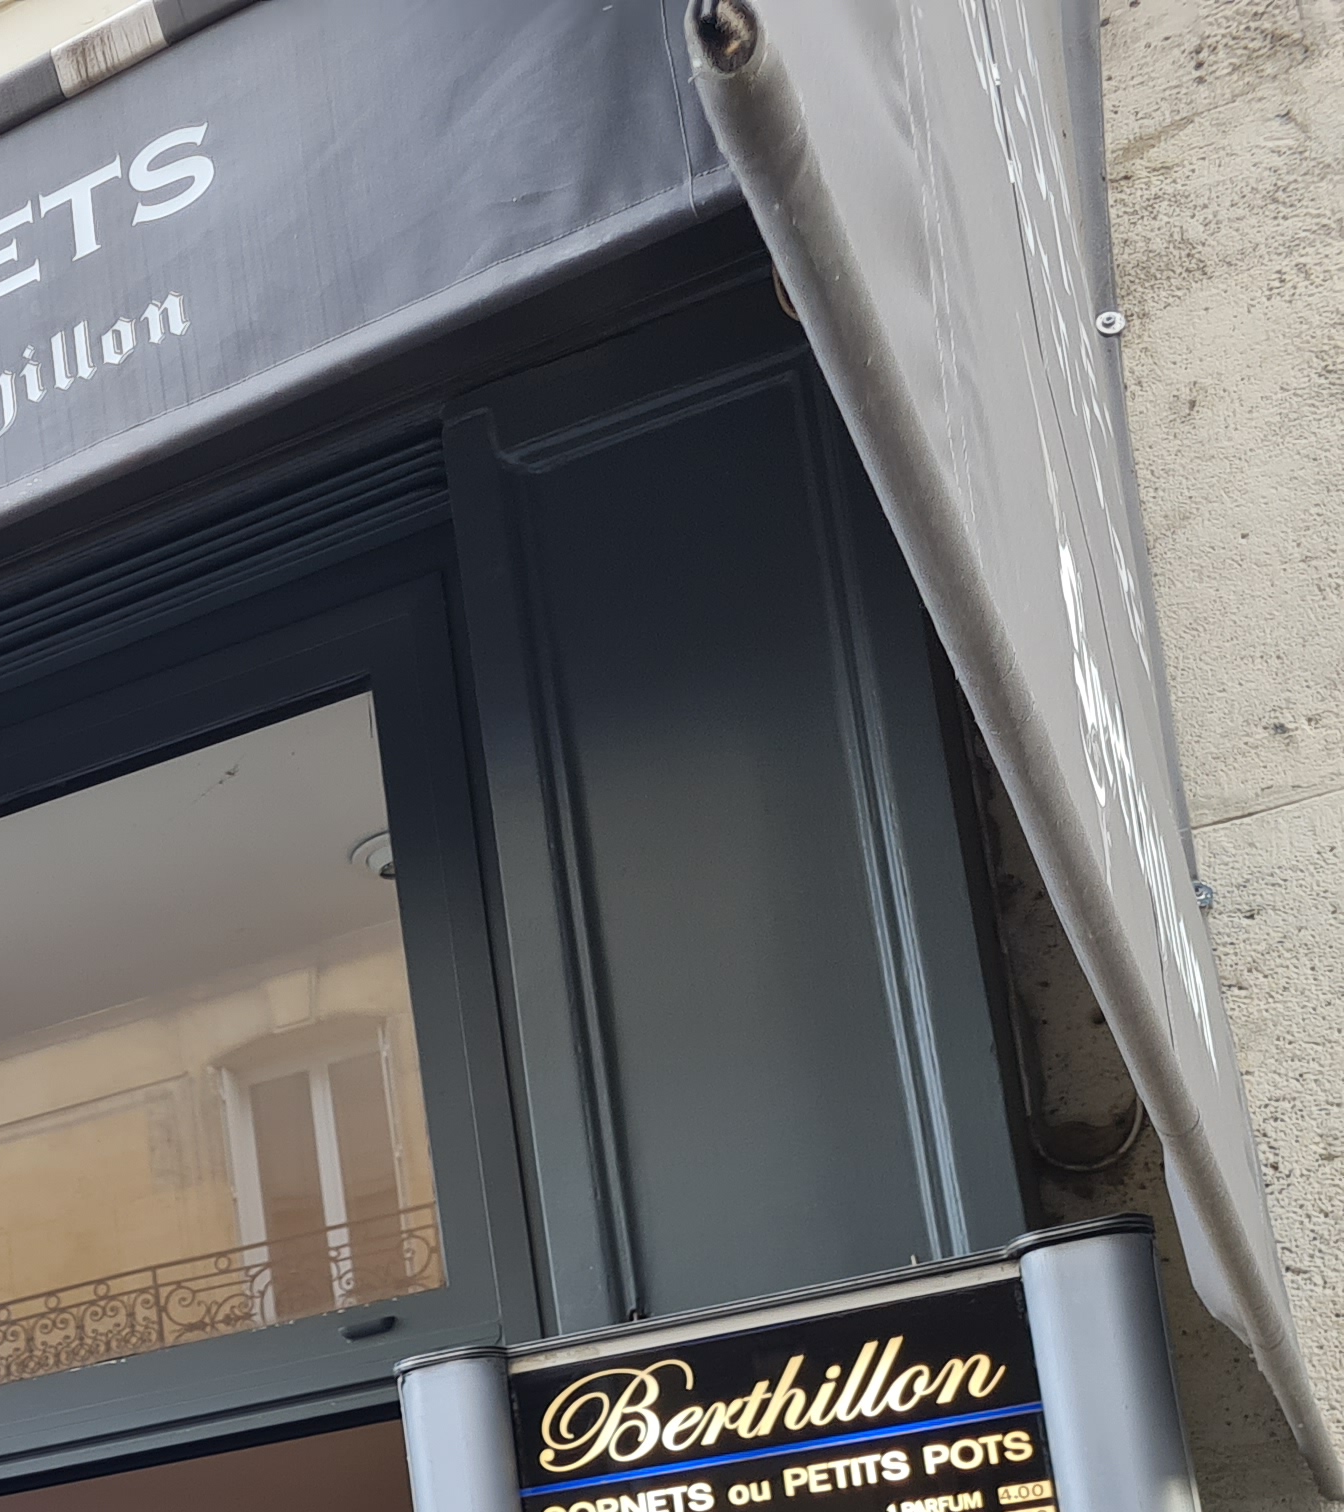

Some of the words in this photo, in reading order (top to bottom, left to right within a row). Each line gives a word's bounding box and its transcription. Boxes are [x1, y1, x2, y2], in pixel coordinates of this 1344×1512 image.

[538, 1335, 1007, 1474] Berthillon
[728, 1481, 772, 1506] ou
[783, 1449, 910, 1497] PETITS
[924, 1430, 1033, 1476] POTS
